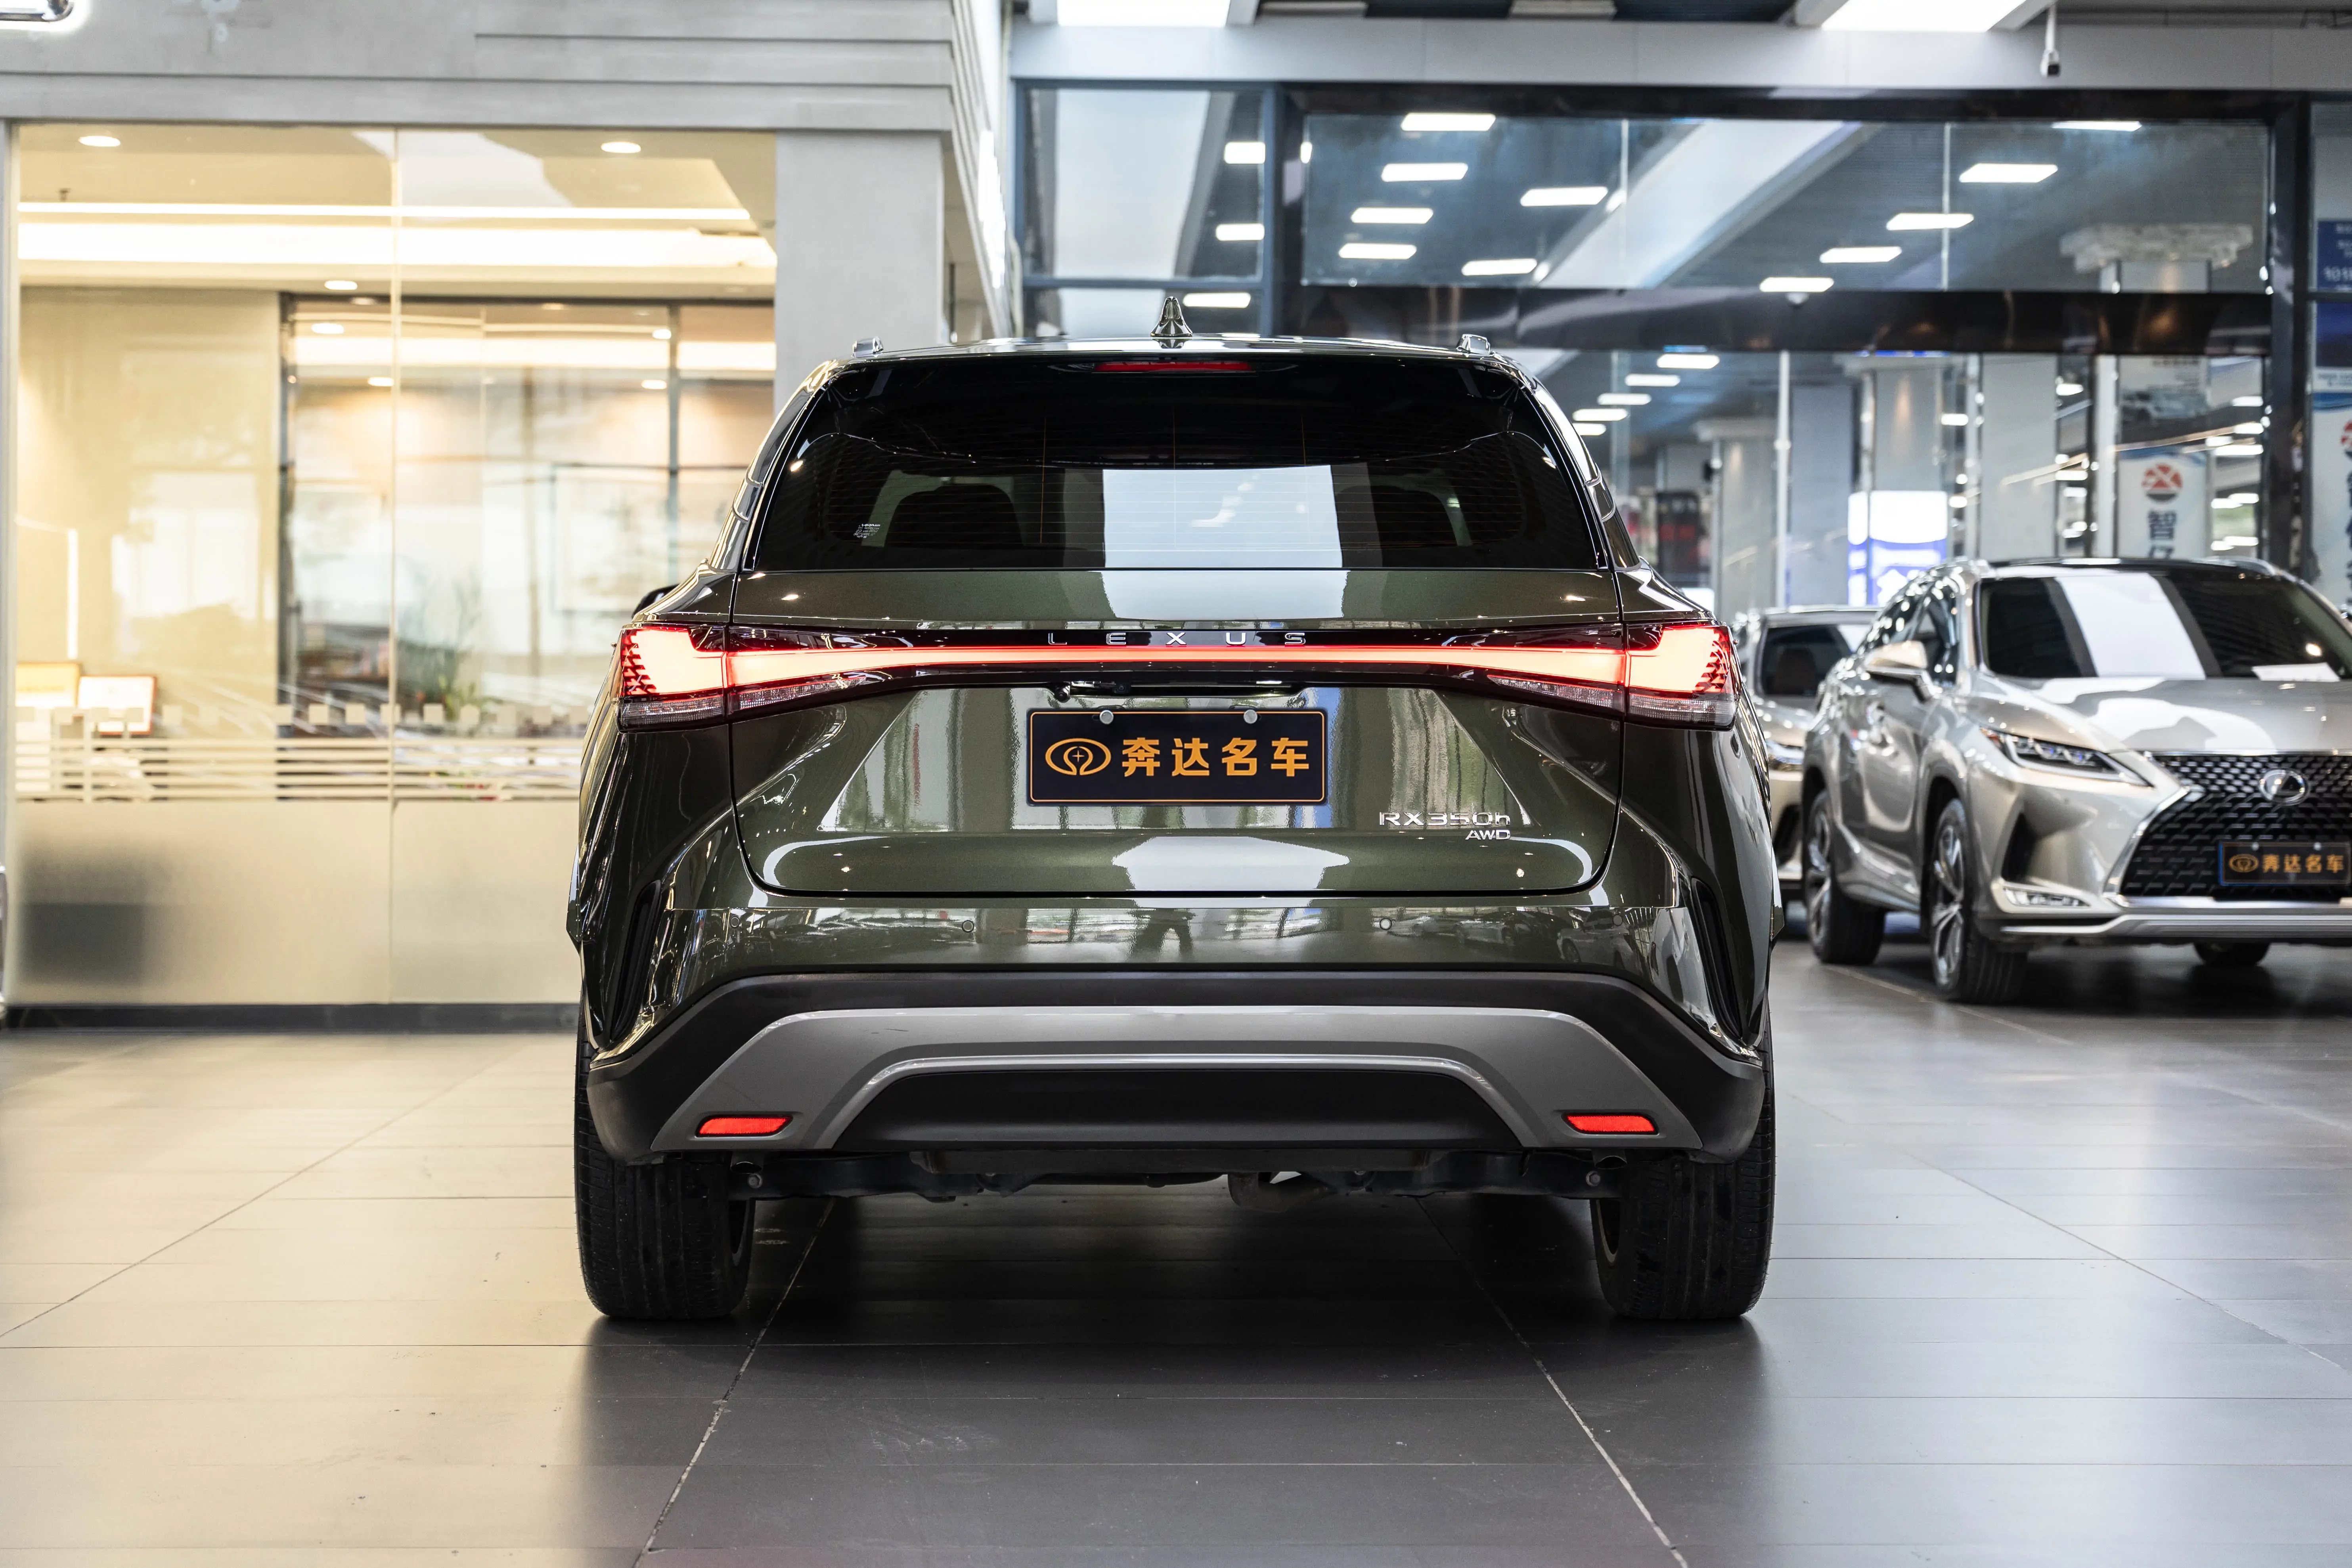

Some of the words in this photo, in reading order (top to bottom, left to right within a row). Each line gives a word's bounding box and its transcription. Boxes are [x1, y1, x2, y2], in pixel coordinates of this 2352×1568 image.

[1048, 632, 1306, 645] LEXUS
[1121, 737, 1310, 777] 奔达名车
[1379, 812, 1511, 826] RX350h
[1465, 829, 1511, 840] AWD
